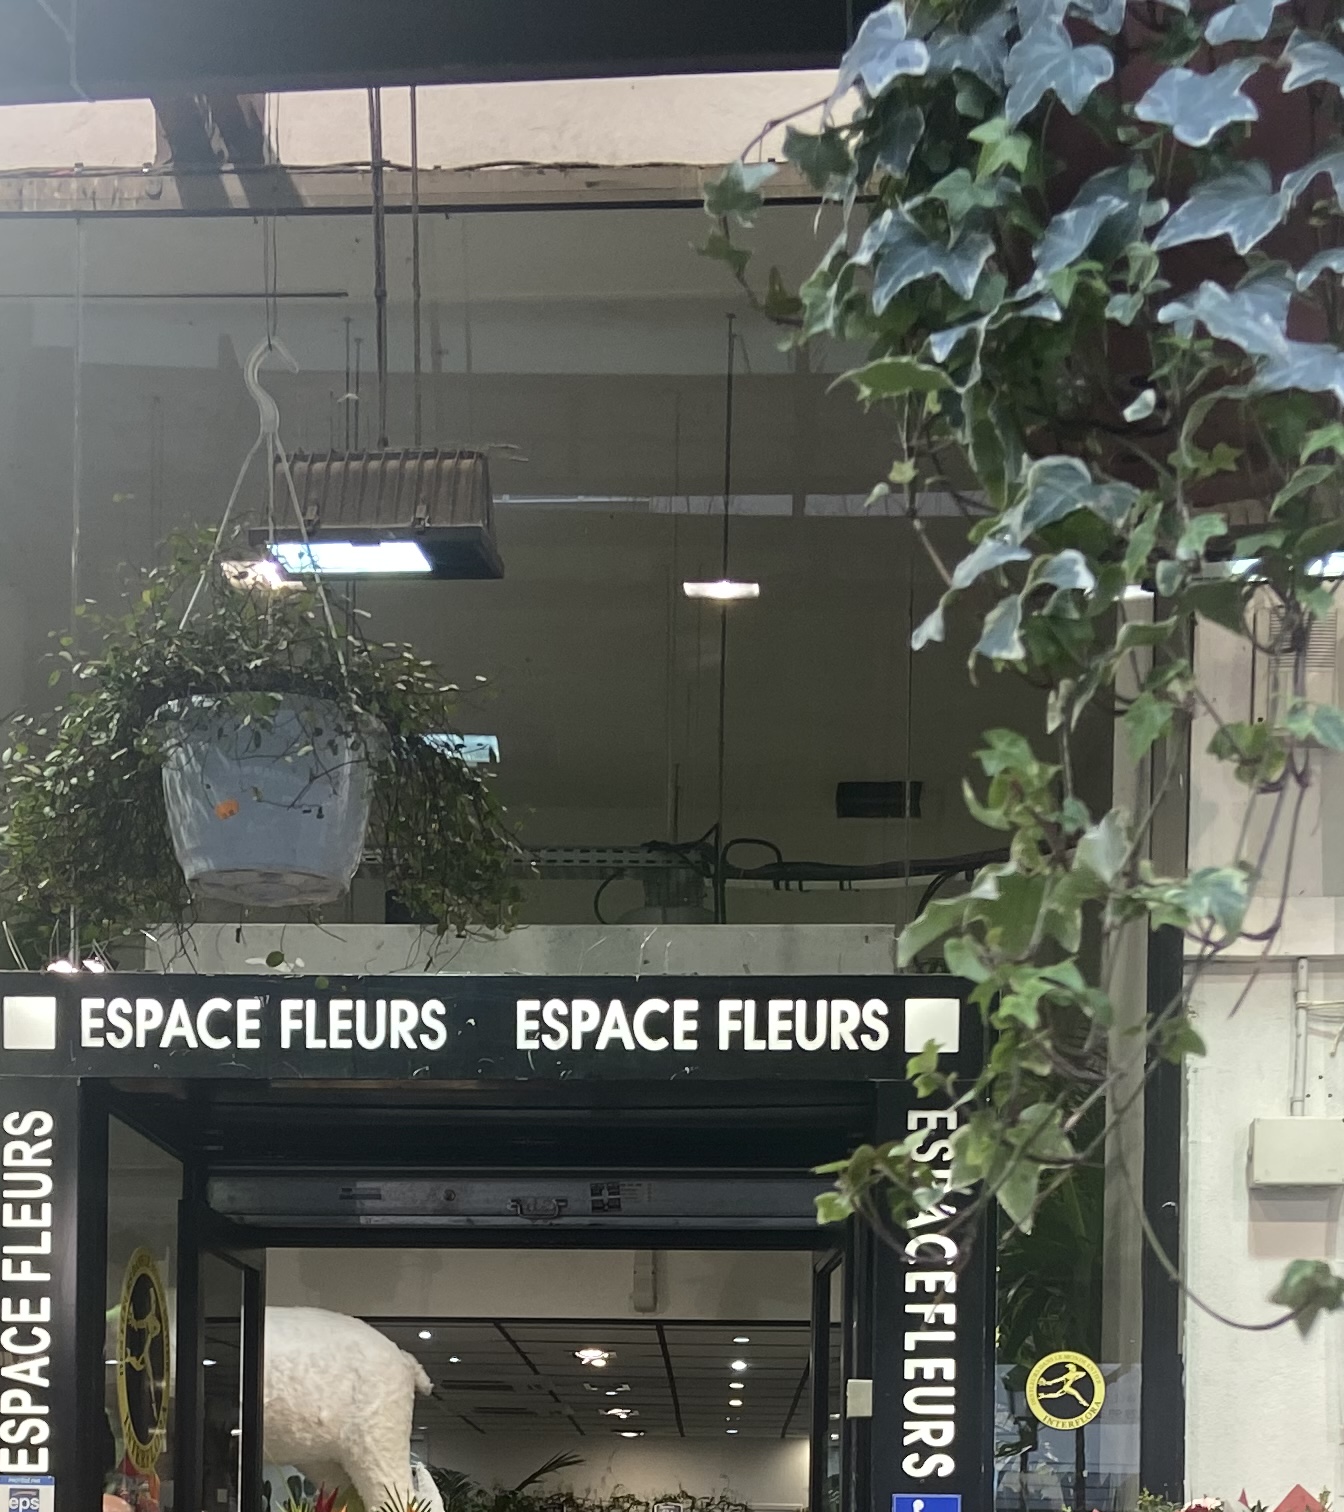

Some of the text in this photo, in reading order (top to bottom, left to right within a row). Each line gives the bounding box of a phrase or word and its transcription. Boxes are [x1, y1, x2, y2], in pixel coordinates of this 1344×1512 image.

[82, 998, 447, 1050] ESPACE FLEURS
[516, 998, 889, 1051] ESPACE FLEURS
[1, 1110, 54, 1281] FLEURS
[0, 1297, 51, 1473] ESPACE
[902, 1303, 956, 1478] FLEURS
[1042, 1400, 1102, 1428] INTERFLORA
